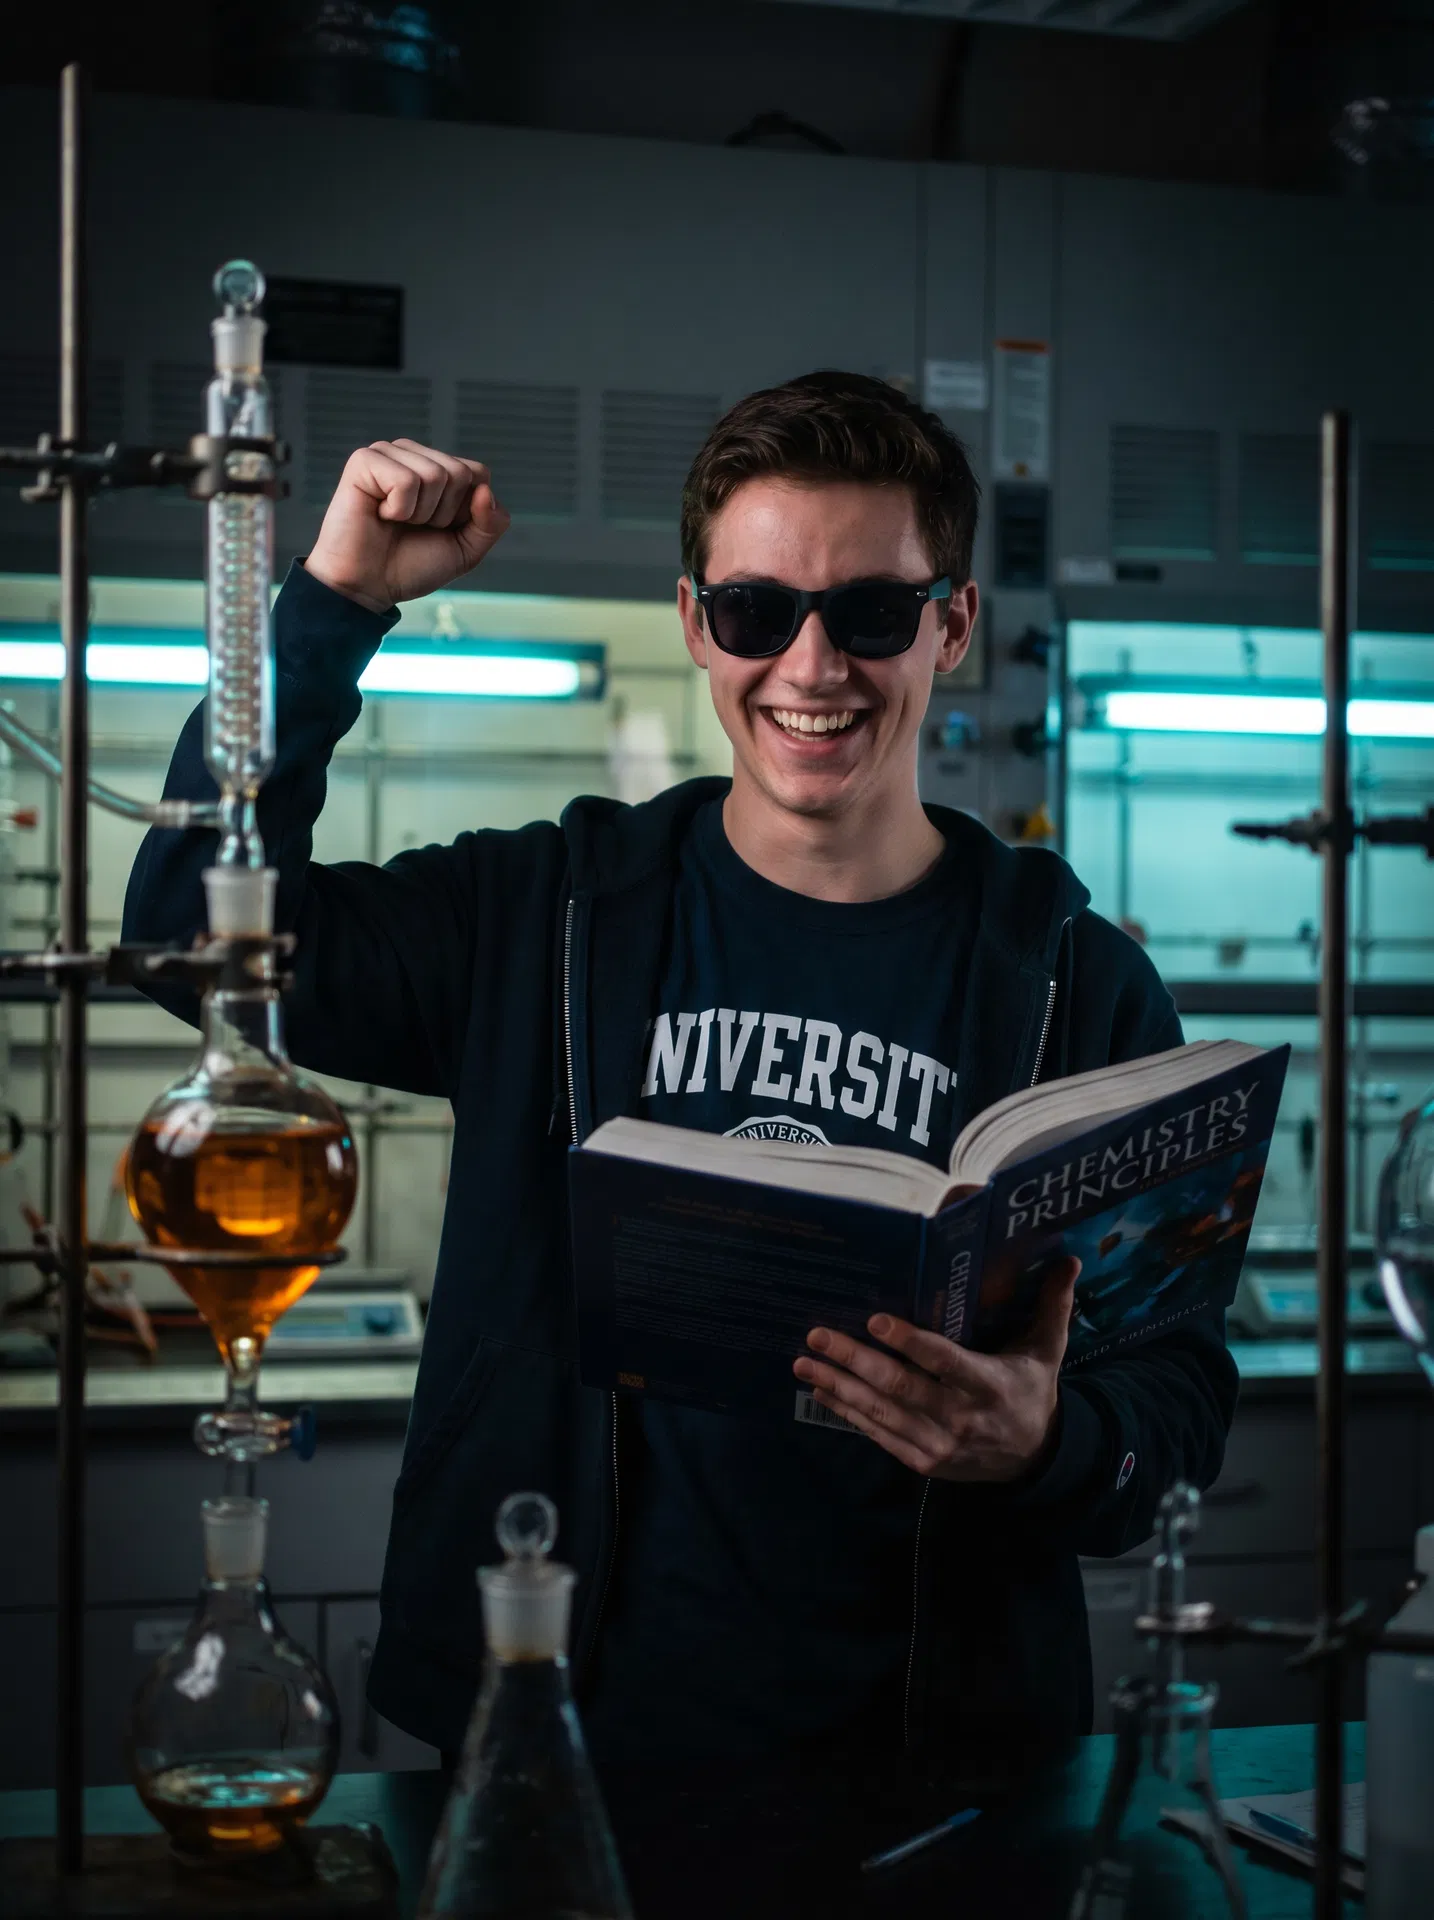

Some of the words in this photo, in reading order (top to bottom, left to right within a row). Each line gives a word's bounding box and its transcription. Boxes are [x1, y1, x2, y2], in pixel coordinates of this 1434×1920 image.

[641, 1008, 957, 1147] NIVERSIT
[1005, 1113, 1249, 1240] PRINCIPLES
[1008, 1080, 1260, 1208] CHEMISTRY
